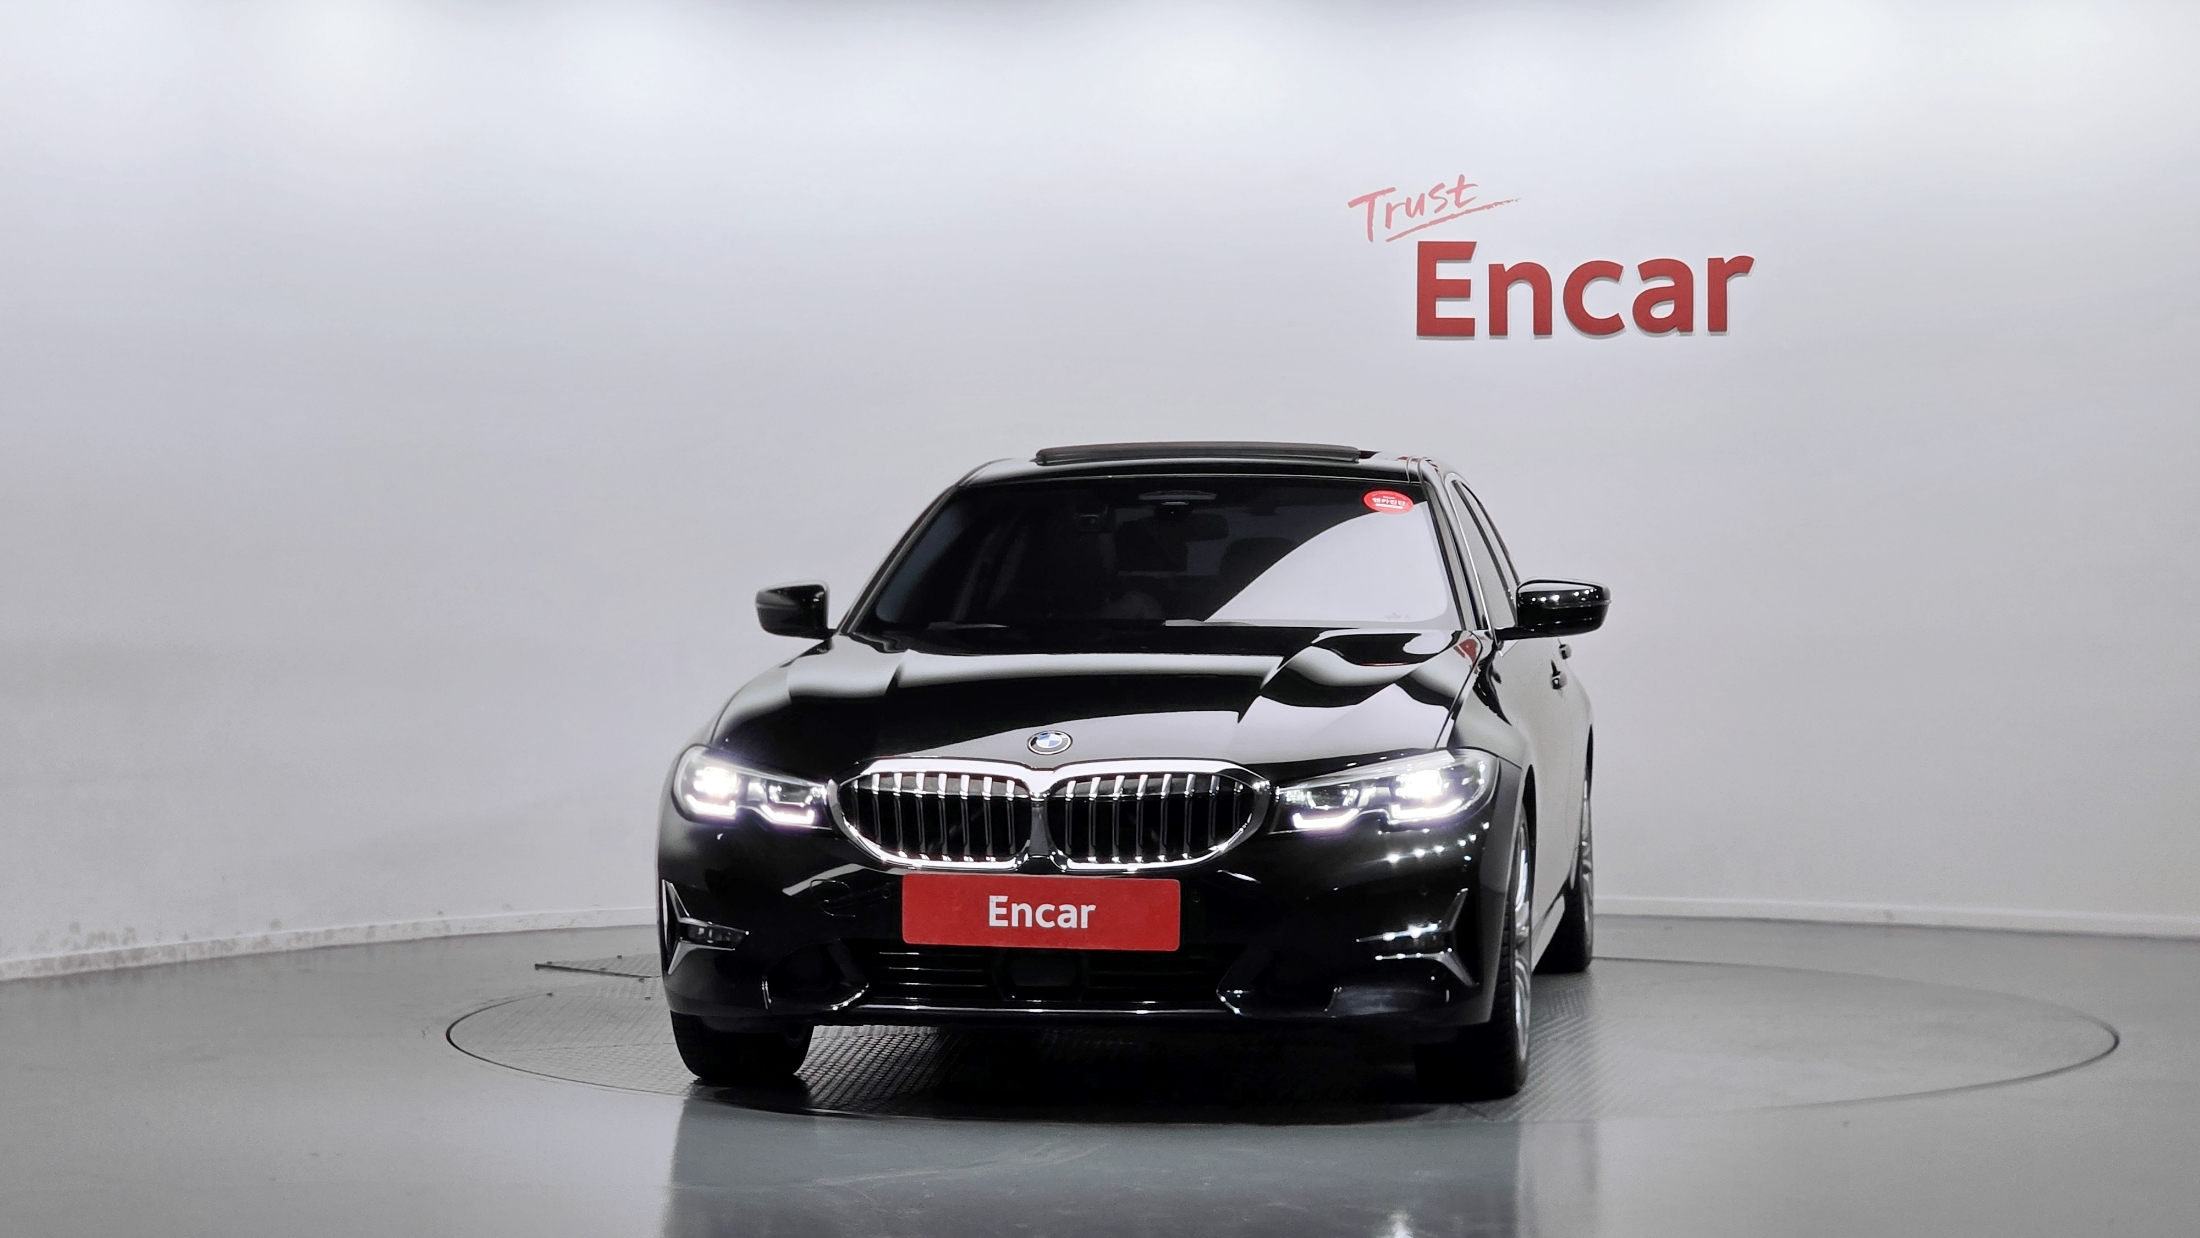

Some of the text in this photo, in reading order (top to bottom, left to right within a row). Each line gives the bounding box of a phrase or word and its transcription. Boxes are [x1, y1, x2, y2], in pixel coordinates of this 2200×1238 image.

[1348, 174, 1479, 242] Trust
[1416, 241, 1755, 337] Encar
[988, 895, 1096, 929] Encar
